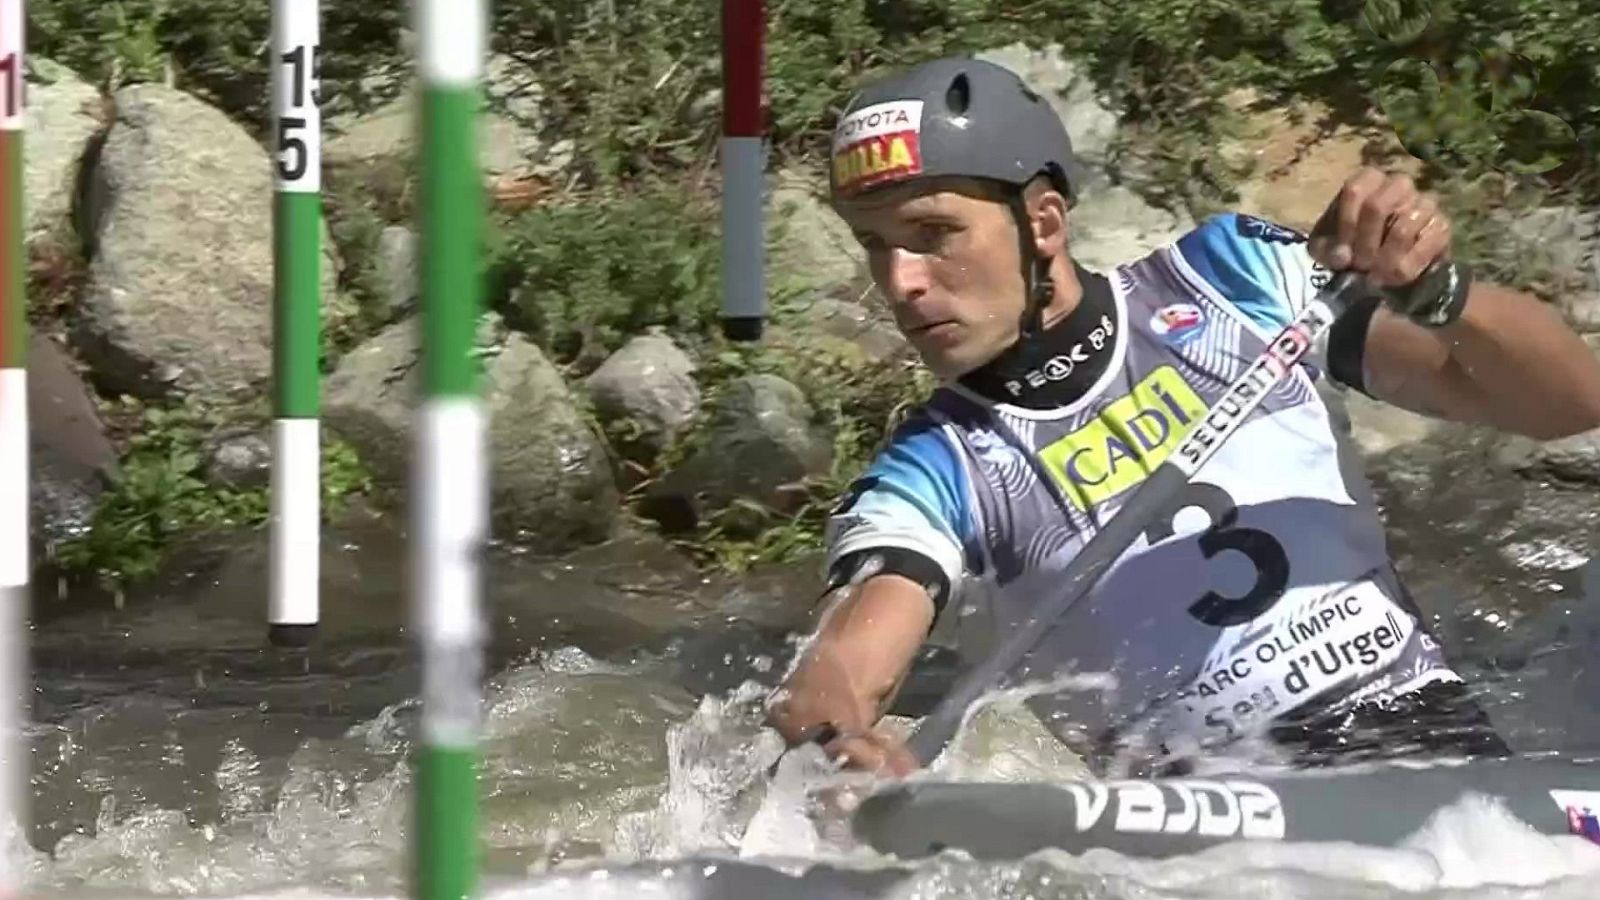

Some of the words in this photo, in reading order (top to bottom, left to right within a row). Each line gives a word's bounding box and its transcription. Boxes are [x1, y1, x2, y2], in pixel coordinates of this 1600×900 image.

[841, 110, 909, 136] OYOTA
[1148, 482, 1290, 627] 3
[1184, 658, 1251, 699] ARC
